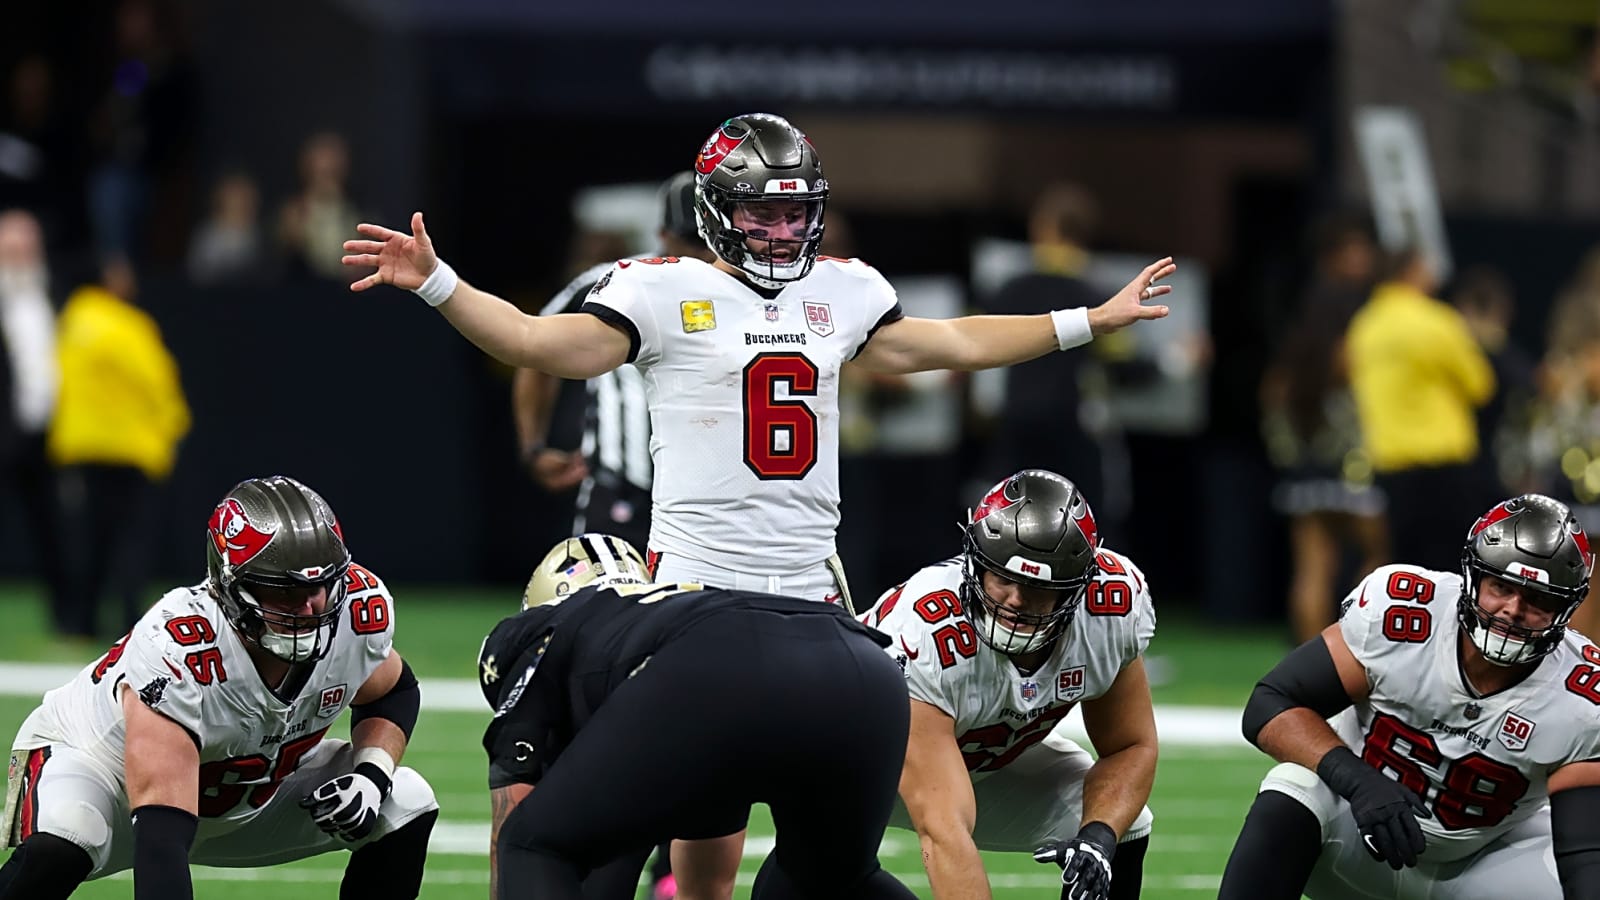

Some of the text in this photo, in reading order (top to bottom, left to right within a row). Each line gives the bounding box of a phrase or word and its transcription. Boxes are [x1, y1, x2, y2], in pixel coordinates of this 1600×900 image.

[806, 305, 829, 323] 50
[744, 332, 807, 346] BUCCANEERS
[743, 352, 819, 481] 6
[913, 588, 979, 669] 62
[1383, 571, 1435, 643] 68
[164, 614, 228, 687] 65
[322, 688, 344, 708] 50
[1060, 669, 1083, 688] 50
[1503, 715, 1531, 740] 50
[1362, 710, 1530, 831] 68
